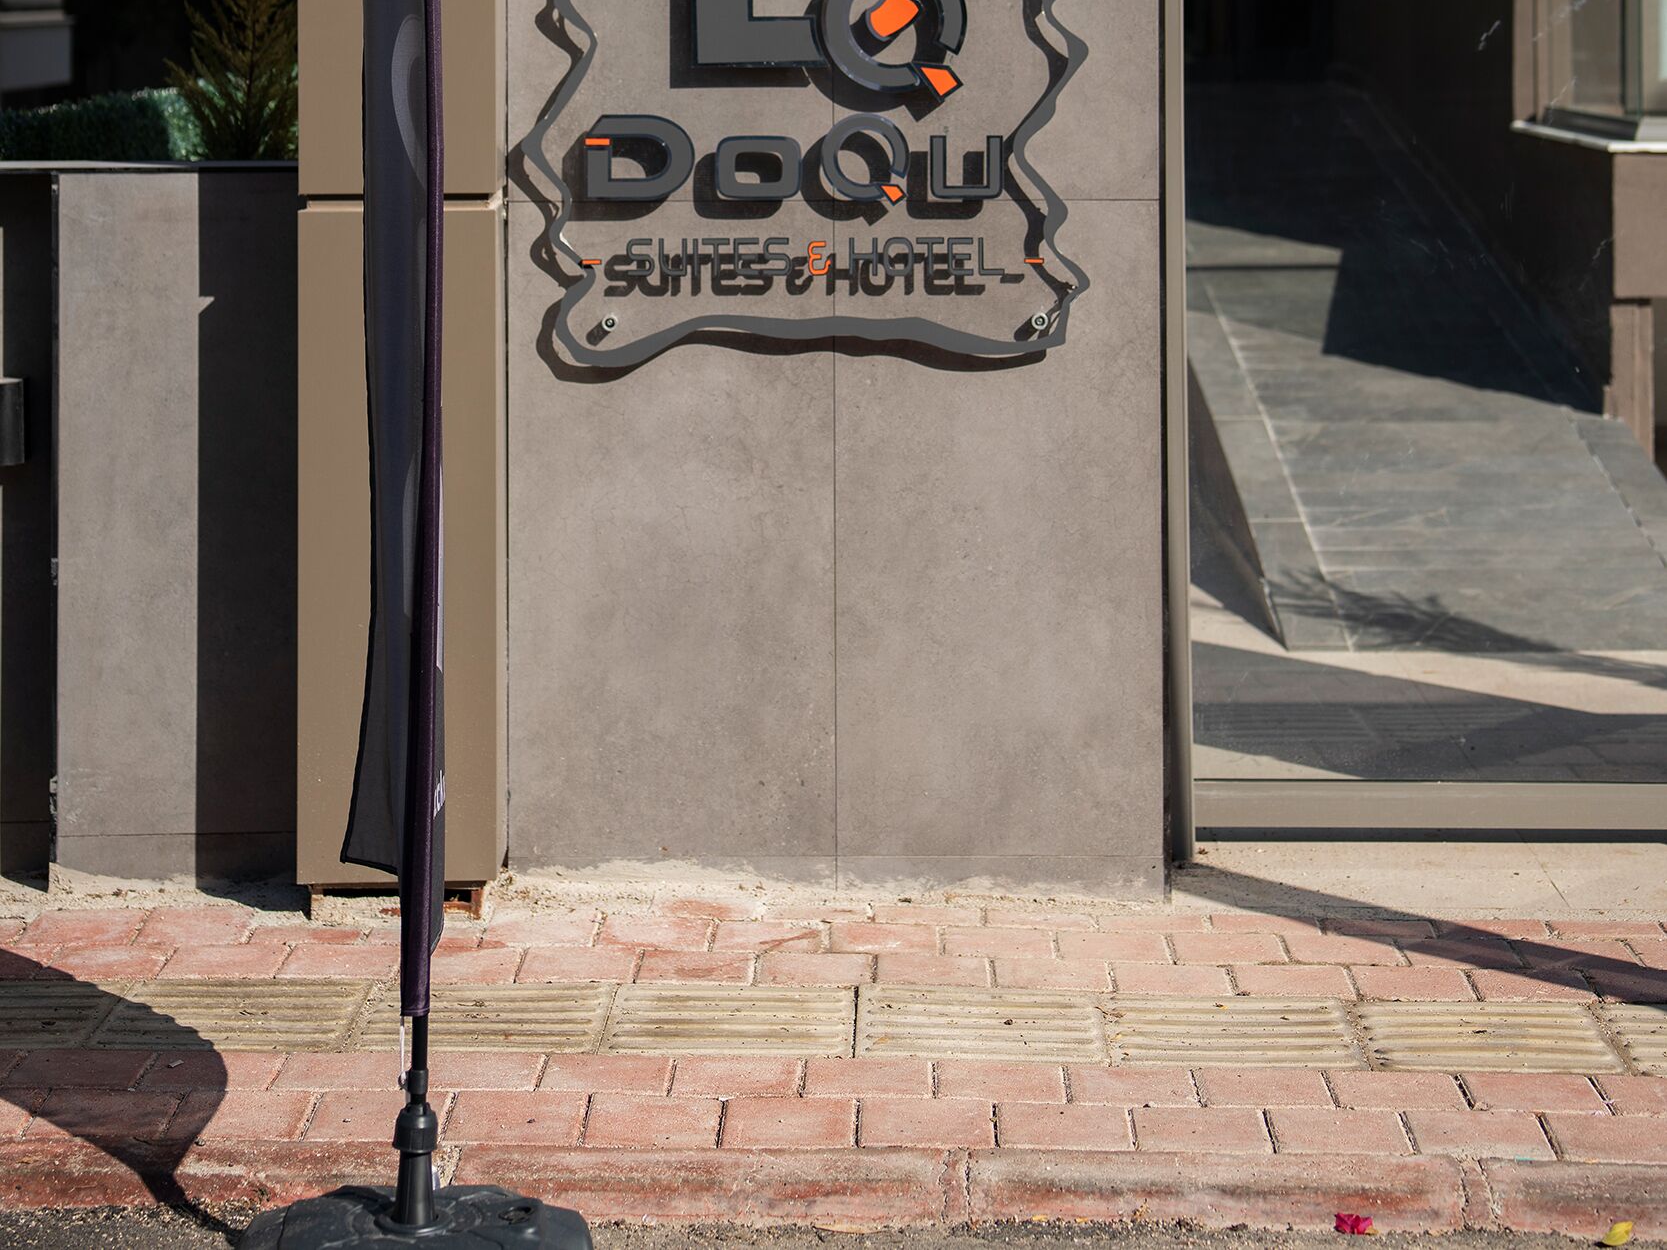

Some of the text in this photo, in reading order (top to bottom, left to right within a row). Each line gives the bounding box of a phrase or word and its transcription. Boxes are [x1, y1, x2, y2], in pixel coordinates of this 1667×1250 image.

[625, 236, 1006, 277] SUITES & HOTEL
